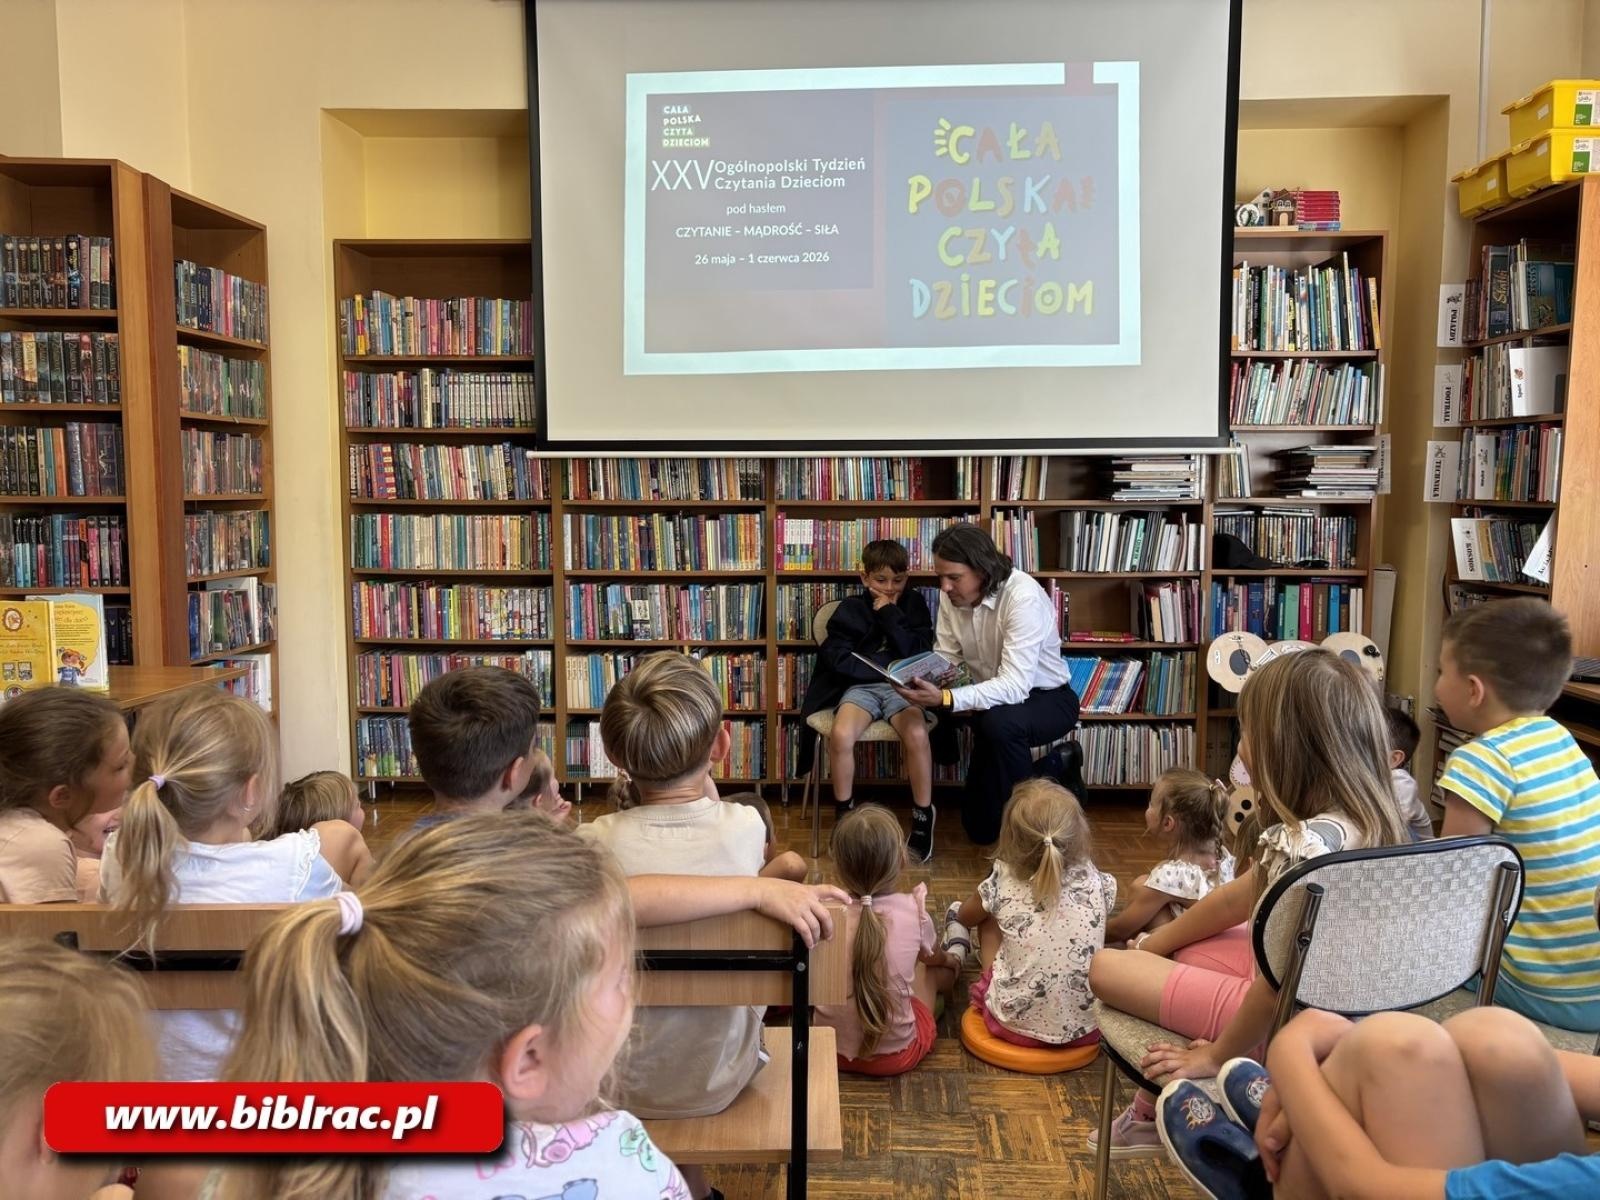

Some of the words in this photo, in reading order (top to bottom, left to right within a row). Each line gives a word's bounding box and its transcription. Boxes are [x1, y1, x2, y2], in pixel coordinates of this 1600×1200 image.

[663, 105, 690, 115] CAŁA
[663, 114, 702, 126] POLSKA
[663, 127, 693, 137] CZYTA
[662, 137, 710, 148] DZIECIOM
[949, 121, 1062, 164] CAŁA
[714, 158, 808, 176] Ogólnopolski
[812, 156, 866, 174] Tydzień
[651, 159, 715, 192] XXV
[714, 176, 776, 192] Czytania
[781, 175, 846, 189] Dzieciom
[726, 203, 747, 216] pod
[749, 202, 787, 214] hasłem
[675, 225, 732, 238] CZYTANIE
[744, 221, 803, 239] MĄDROŚĆ
[814, 223, 840, 236] SIŁA
[695, 253, 709, 265] 26
[711, 253, 736, 267] maja
[749, 253, 754, 264] 1
[757, 253, 800, 264] czerwca
[802, 251, 830, 263] 2026
[1449, 309, 1458, 342] POJAZDY
[1443, 385, 1452, 423] FOOTBALL
[1432, 460, 1442, 498] TECHNIKA
[1465, 542, 1476, 573] KOSMOS
